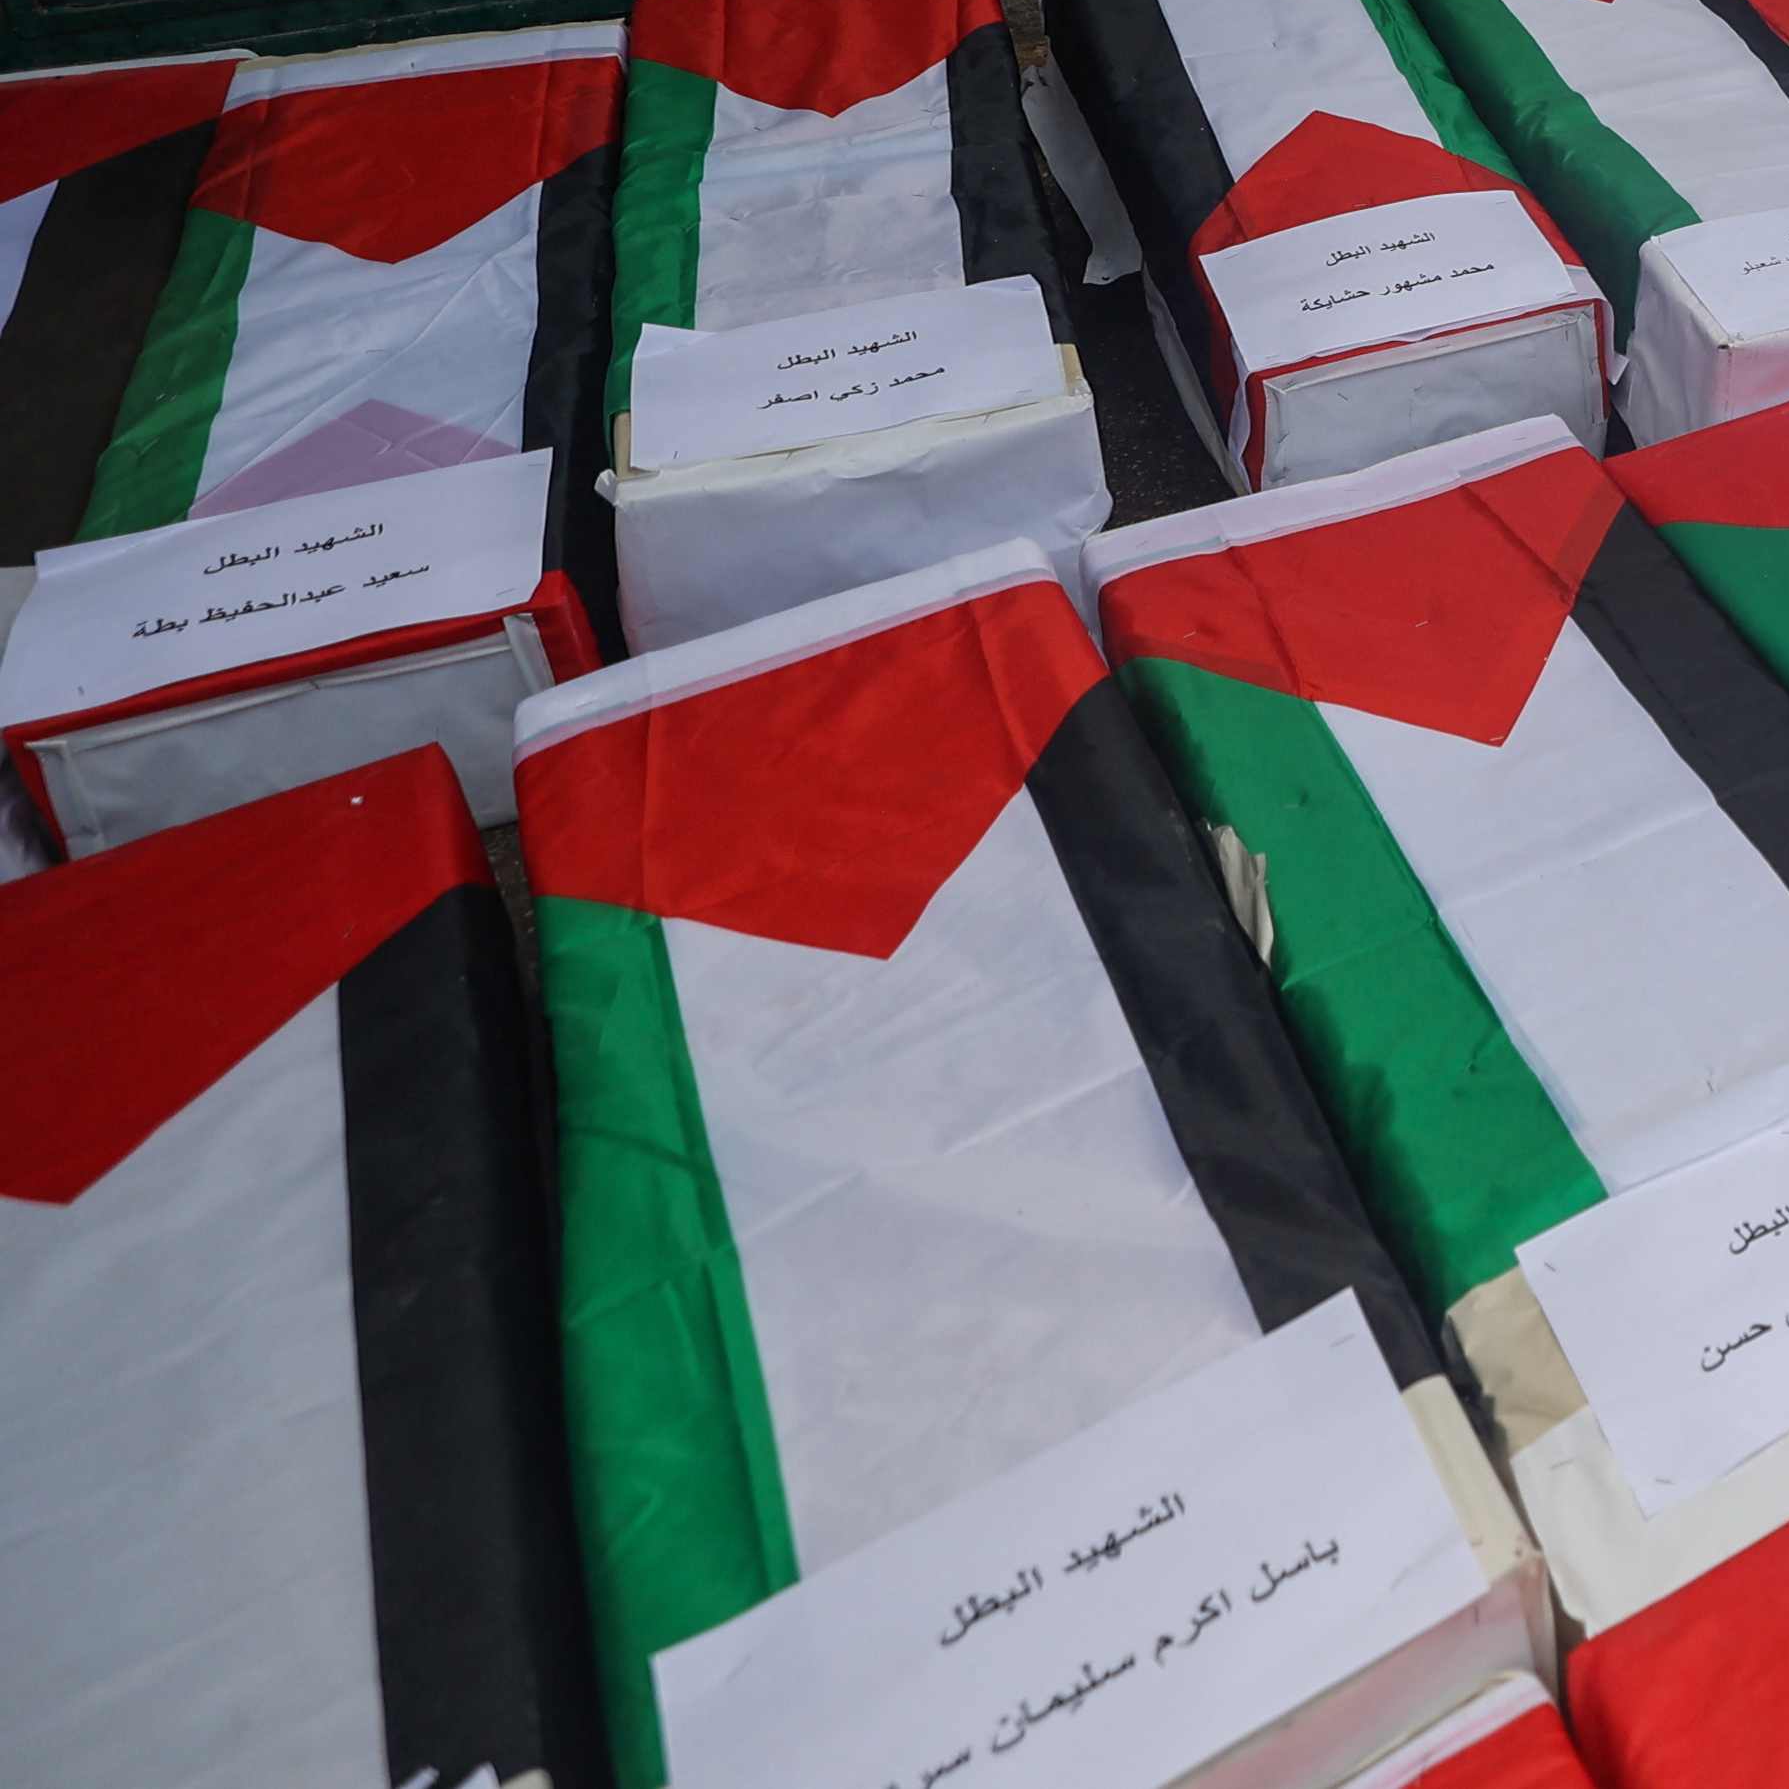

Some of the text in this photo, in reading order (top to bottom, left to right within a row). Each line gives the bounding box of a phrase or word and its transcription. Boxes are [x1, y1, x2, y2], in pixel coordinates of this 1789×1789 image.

[1327, 233, 1435, 266] الشهيد البطل
[1301, 264, 1494, 311] محمد مشهور حشايكة
[778, 331, 916, 369] الشهيد البطل
[830, 382, 878, 401] زكي
[889, 368, 944, 387] محمد
[204, 524, 383, 574] الشهيد البطل
[133, 619, 188, 637] بطة
[1701, 1324, 1772, 1372] حسن
[940, 1493, 1184, 1647] الشهيد البطل
[990, 1540, 1339, 1755] باسل اكرم سليمان
